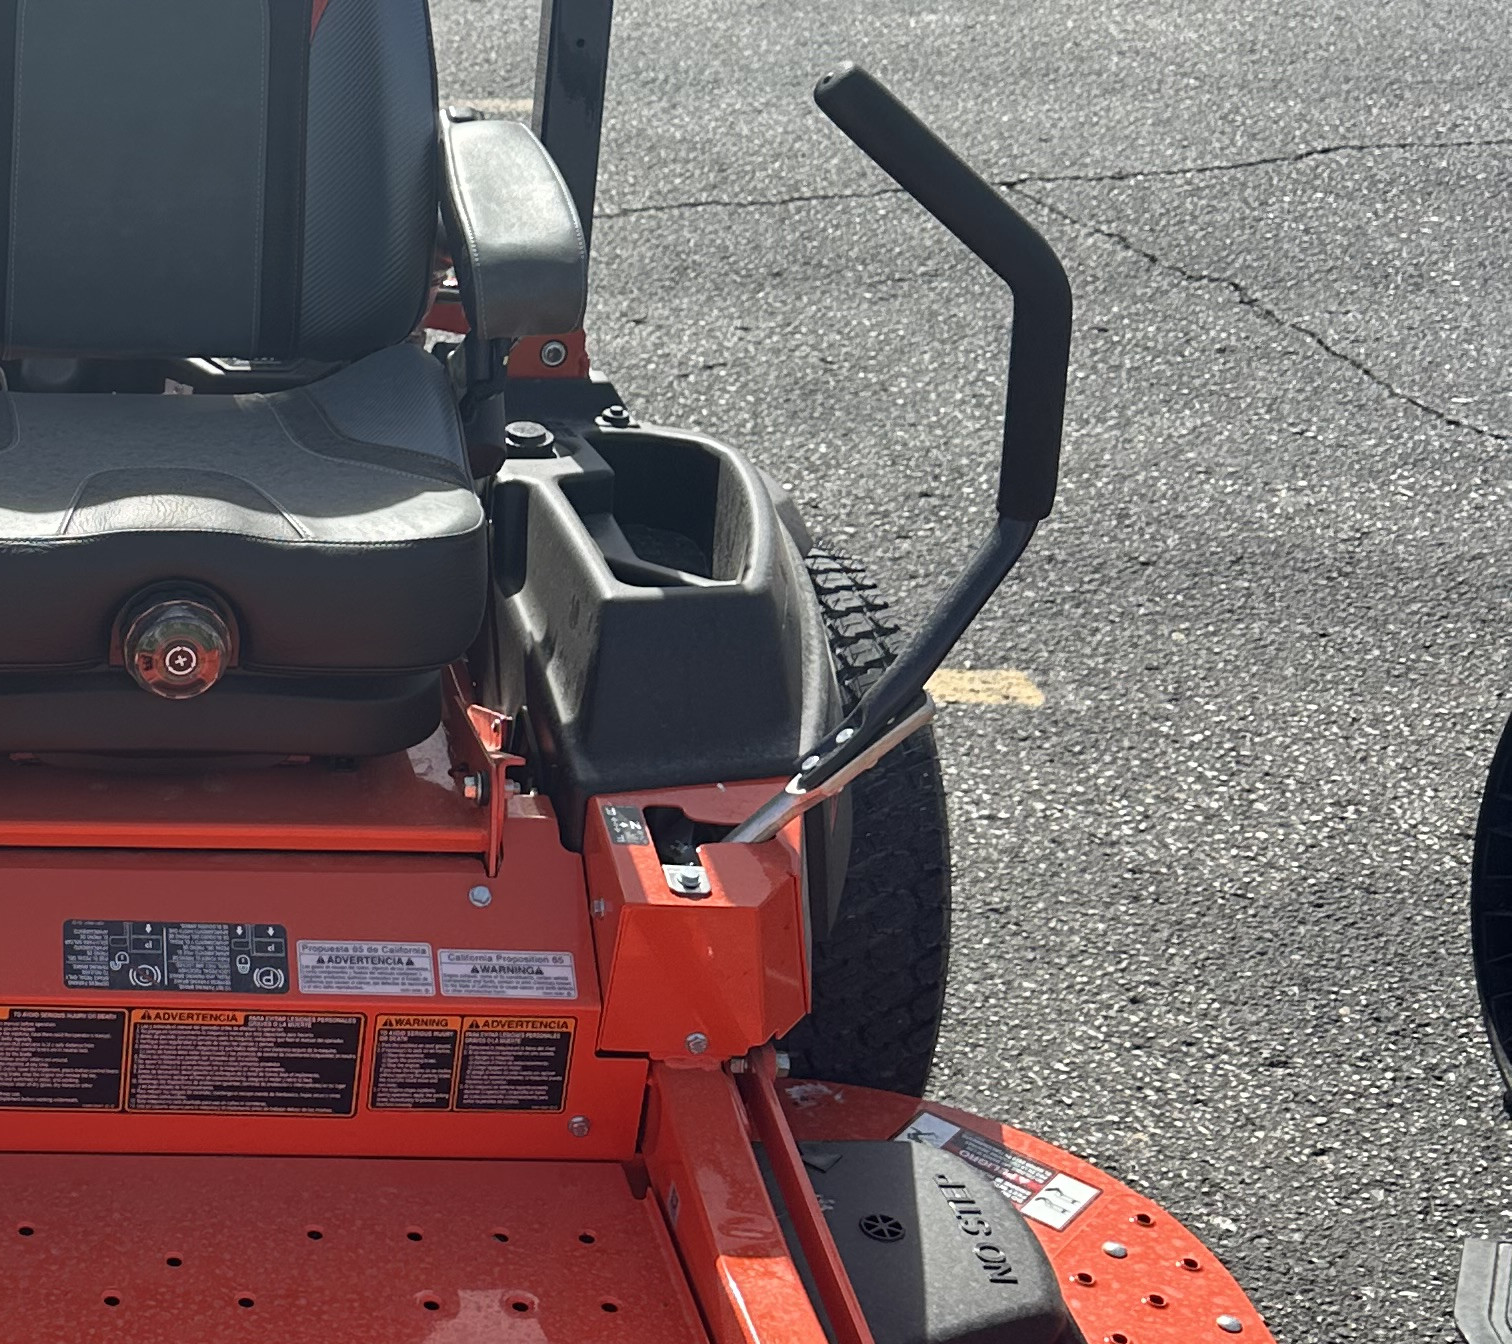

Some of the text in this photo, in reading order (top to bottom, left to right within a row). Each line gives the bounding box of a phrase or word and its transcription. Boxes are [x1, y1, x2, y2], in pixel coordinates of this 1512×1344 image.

[301, 944, 427, 955] Propuesta 65 de California
[327, 956, 403, 966] ADVERTENCIA
[447, 954, 564, 965] California Proposition 65
[480, 965, 536, 975] WARNING
[154, 1011, 238, 1022] ADVERTENCIA
[395, 1019, 449, 1027] WARNING
[482, 1020, 569, 1030] ADVERTENCIA
[973, 1242, 1019, 1285] NO
